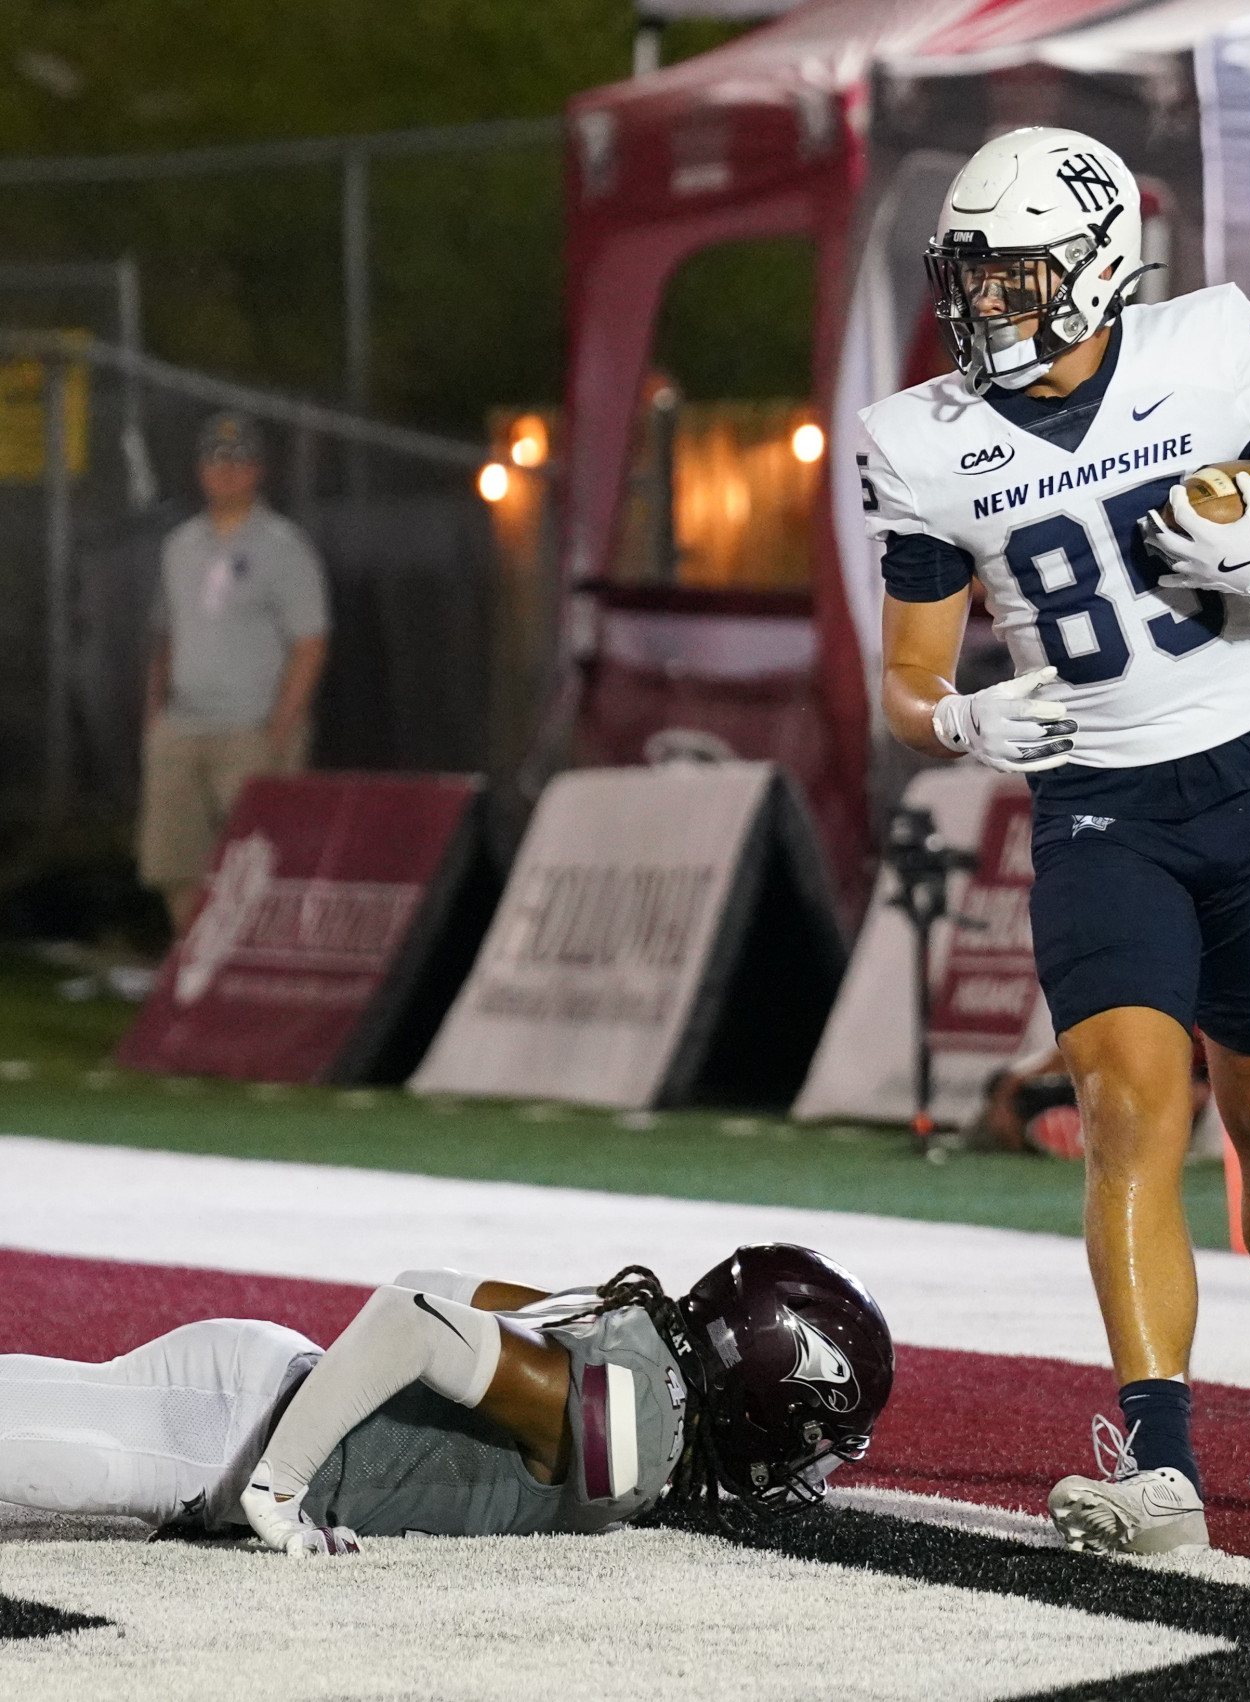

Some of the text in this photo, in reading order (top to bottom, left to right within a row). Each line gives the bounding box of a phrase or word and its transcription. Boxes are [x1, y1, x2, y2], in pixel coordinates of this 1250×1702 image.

[953, 231, 974, 242] UNH
[960, 445, 1006, 470] CAA
[973, 484, 1029, 519] NEW
[1038, 433, 1193, 499] HAMPSHIRE
[1000, 470, 1227, 690] 85
